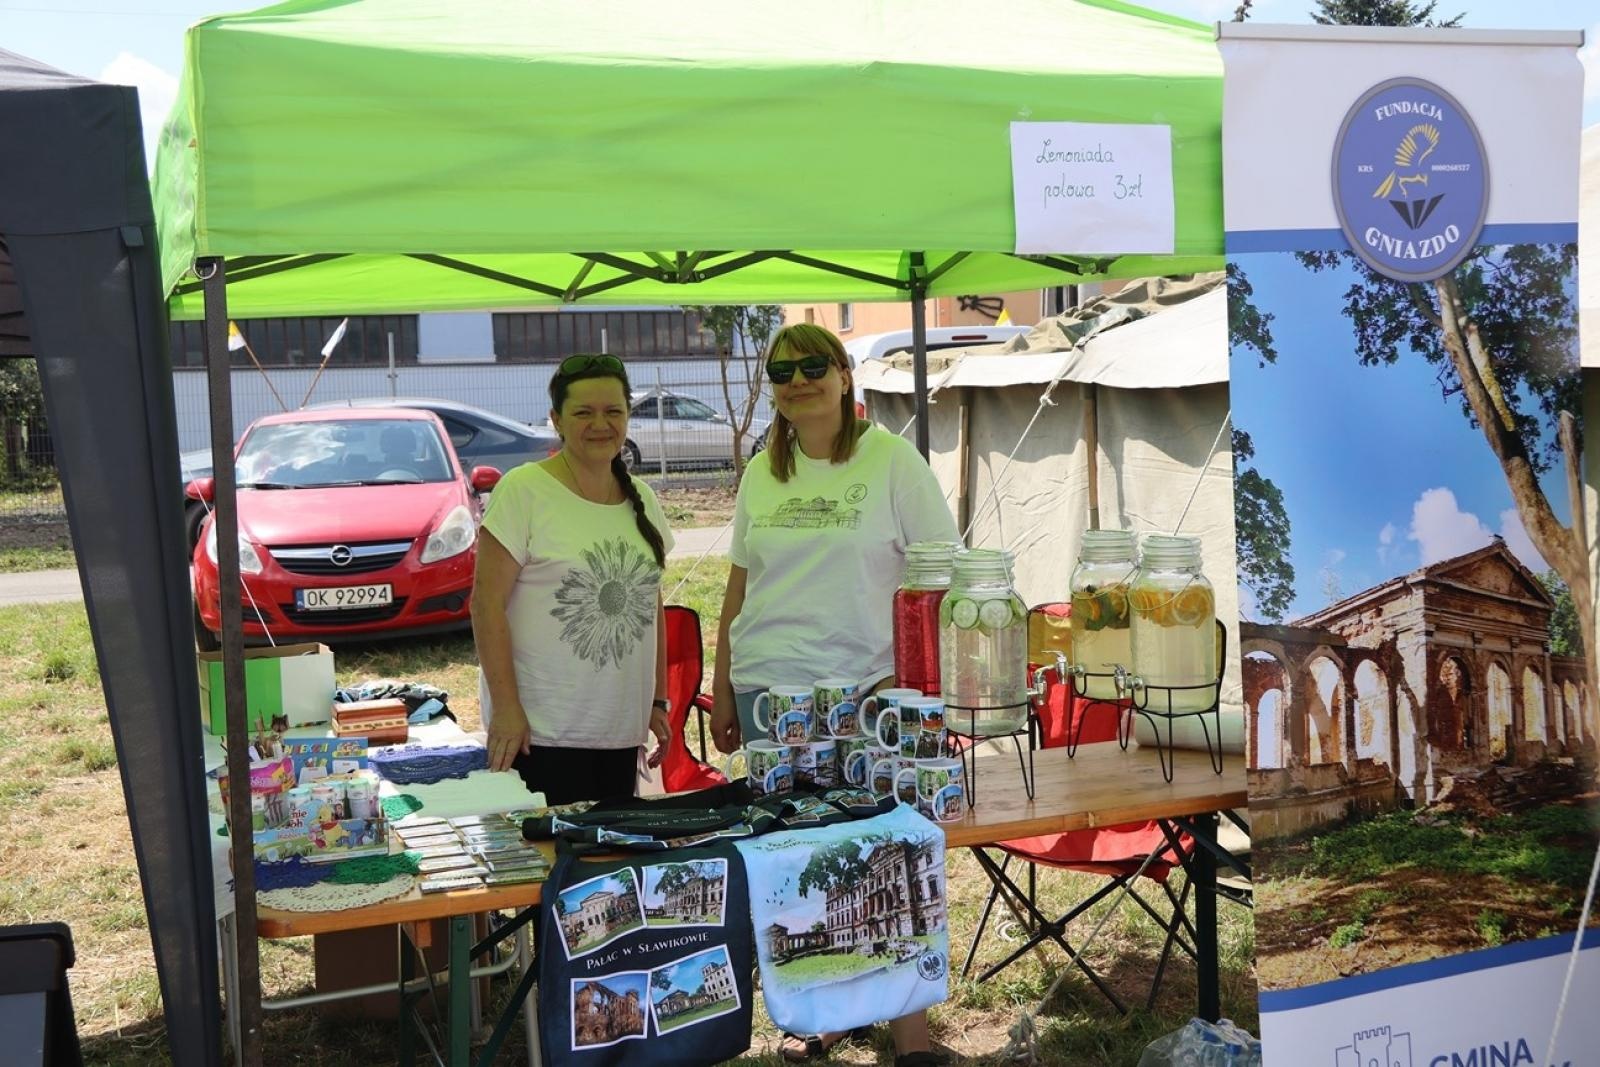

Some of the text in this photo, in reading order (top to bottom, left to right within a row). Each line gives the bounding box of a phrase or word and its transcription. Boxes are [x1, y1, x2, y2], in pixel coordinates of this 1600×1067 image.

[1375, 101, 1443, 122] FUNDACJA
[1036, 139, 1114, 164] Lemoniada
[1357, 165, 1373, 173] KRS
[1365, 224, 1460, 259] GNIAZDO
[307, 586, 388, 607] OK 92994
[586, 950, 618, 970] PAŁAC
[638, 932, 710, 953] SŁAWIKOWIE
